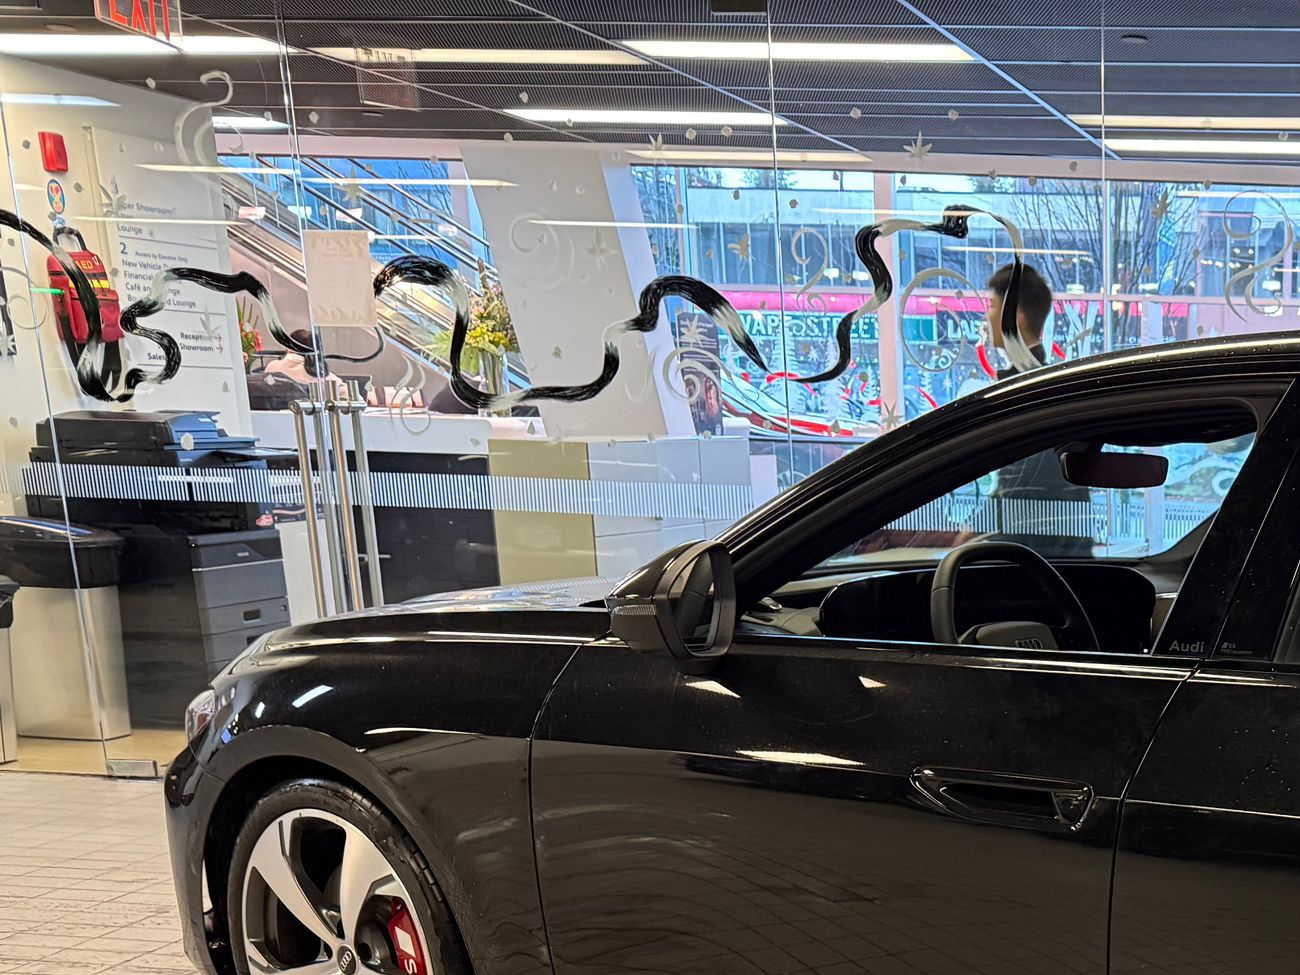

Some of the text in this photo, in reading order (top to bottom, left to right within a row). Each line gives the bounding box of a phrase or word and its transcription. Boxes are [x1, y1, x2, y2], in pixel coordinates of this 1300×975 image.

[119, 242, 128, 255] 2
[121, 259, 137, 267] New
[138, 260, 162, 270] Vehicle
[125, 282, 141, 291] Café
[172, 299, 196, 308] Lounge
[1168, 640, 1205, 653] Audi
[404, 958, 417, 975] S
